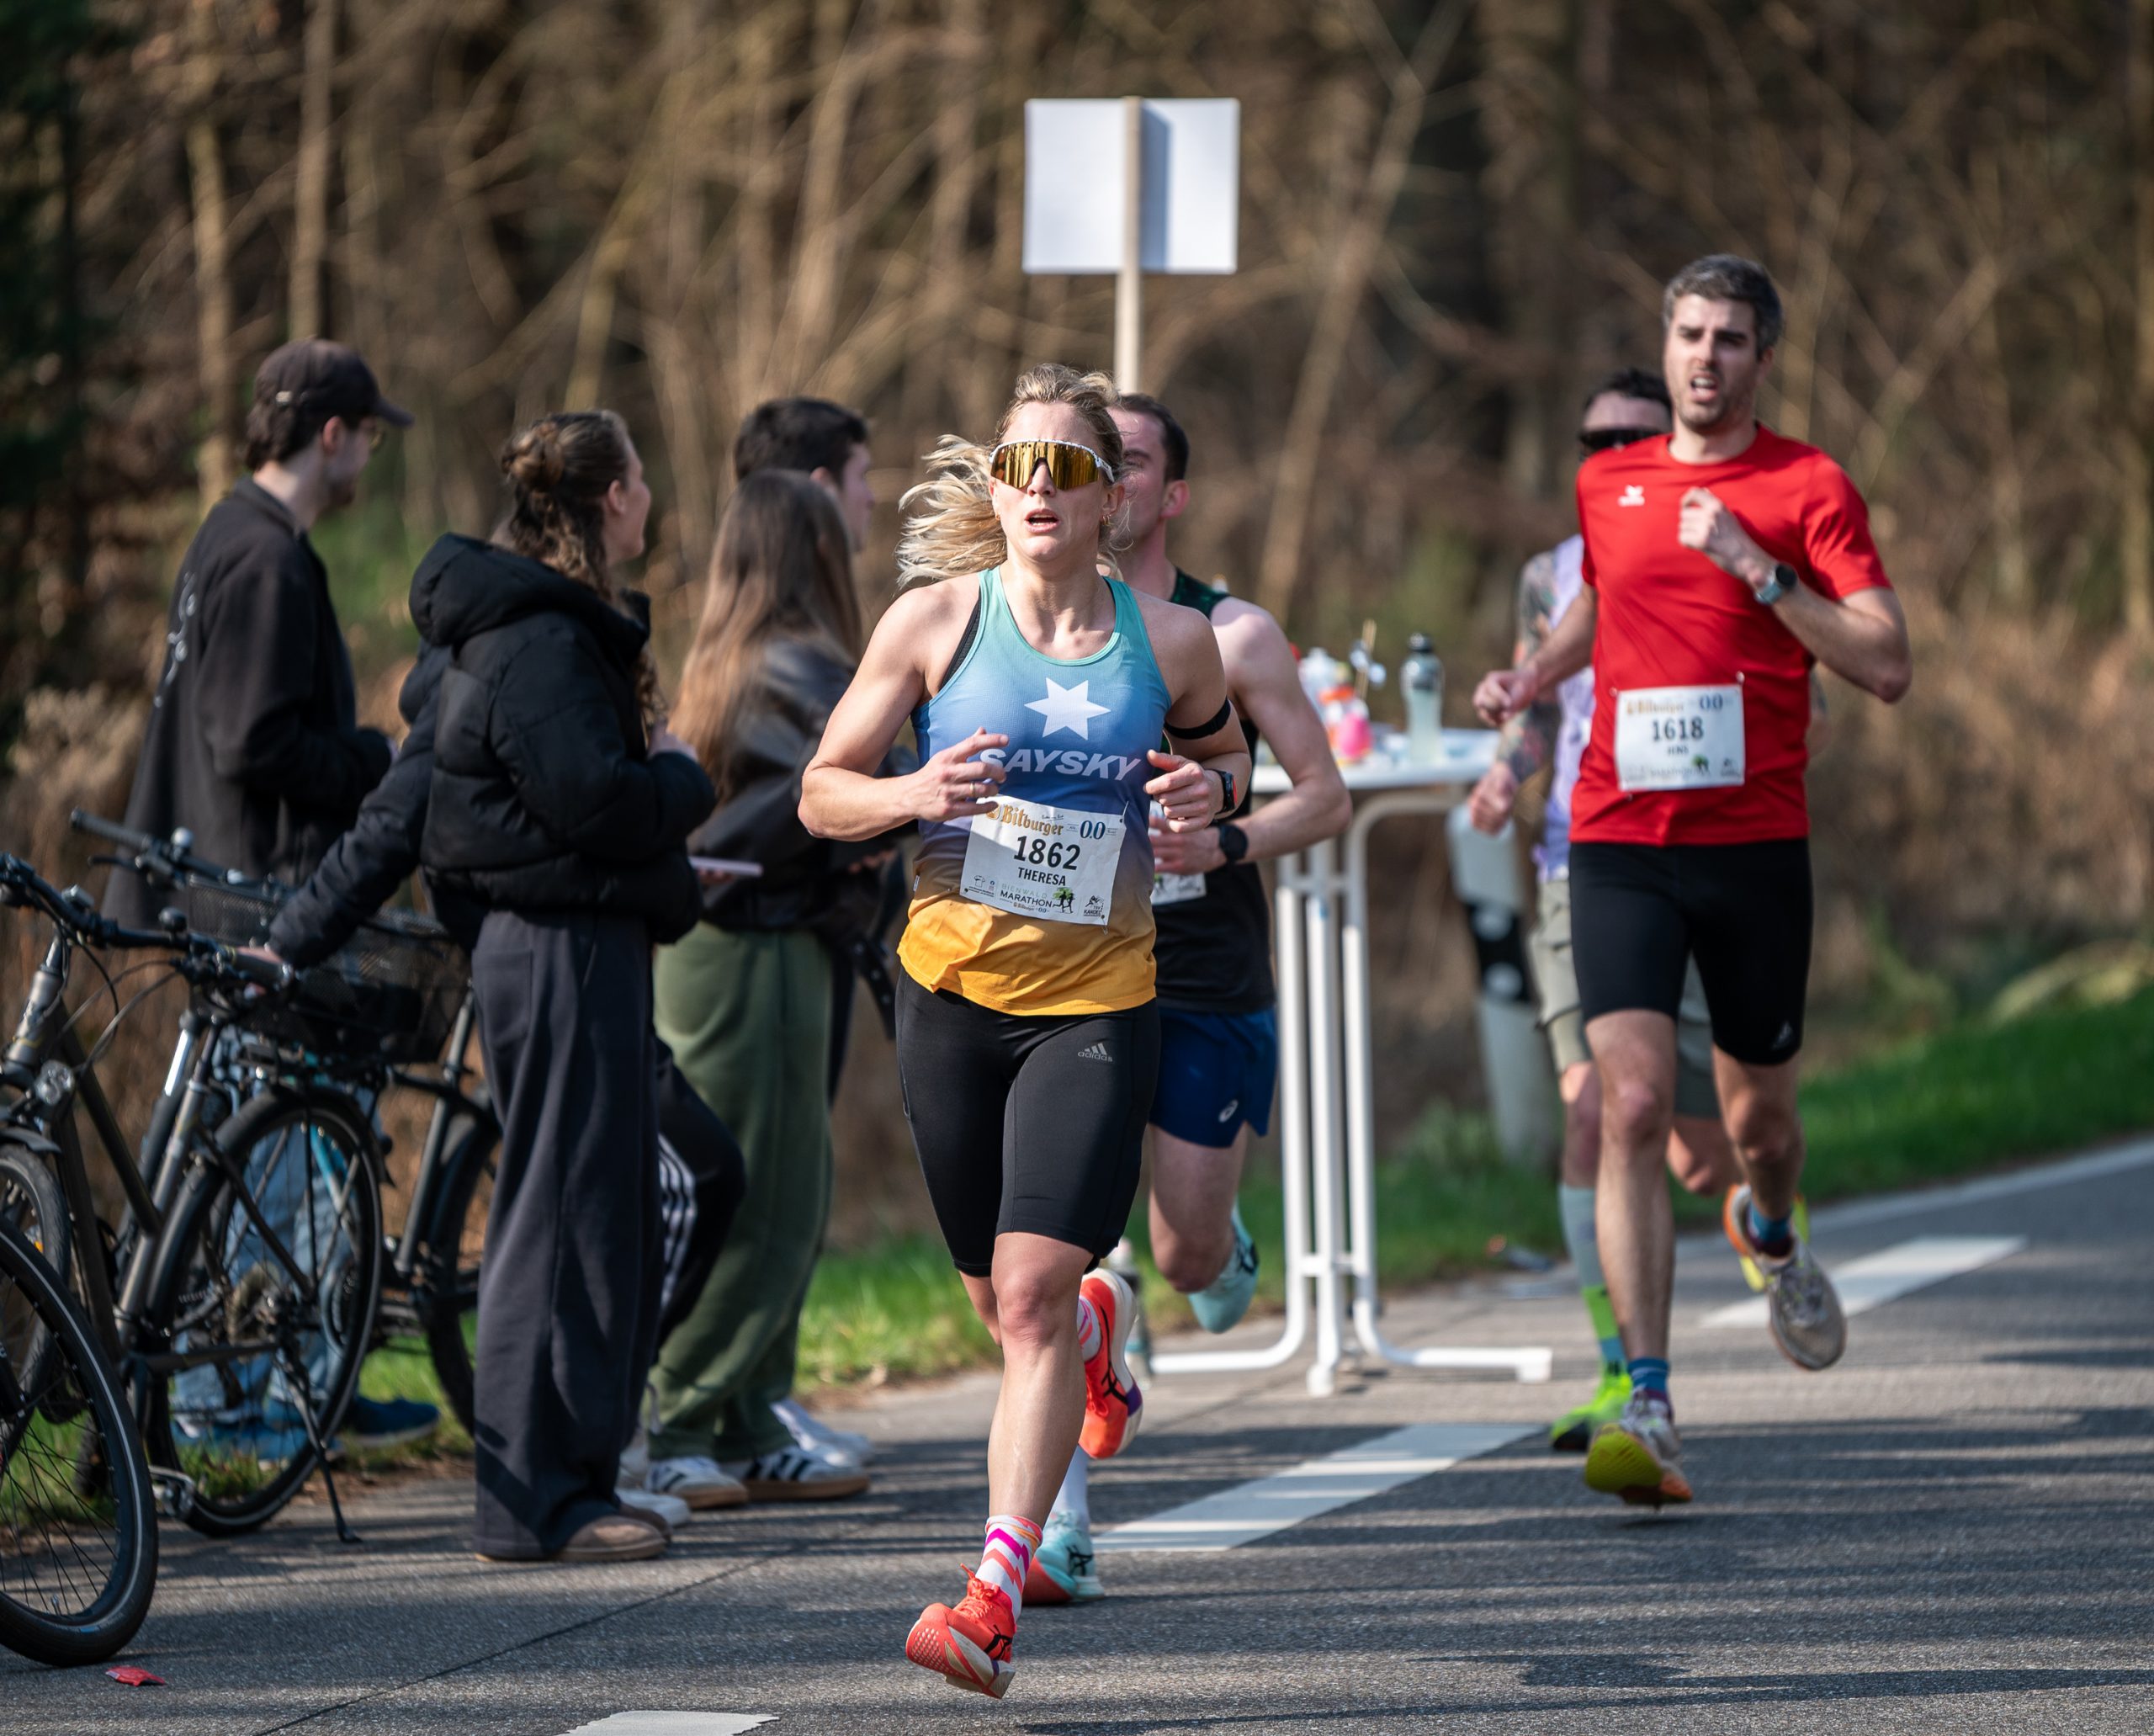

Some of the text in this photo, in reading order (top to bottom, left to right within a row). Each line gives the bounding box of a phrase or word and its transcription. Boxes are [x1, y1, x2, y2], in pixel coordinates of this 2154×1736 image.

[1652, 715, 1705, 742] 1618
[979, 748, 1142, 781] SAYSKY
[1000, 804, 1106, 840] Bitburger 0.0
[1013, 835, 1081, 871] 1862
[1017, 867, 1067, 887] THERESA
[1000, 889, 1053, 908] MARATHON
[1001, 883, 1048, 898] BIENWALD
[1077, 1051, 1113, 1062] adidas
